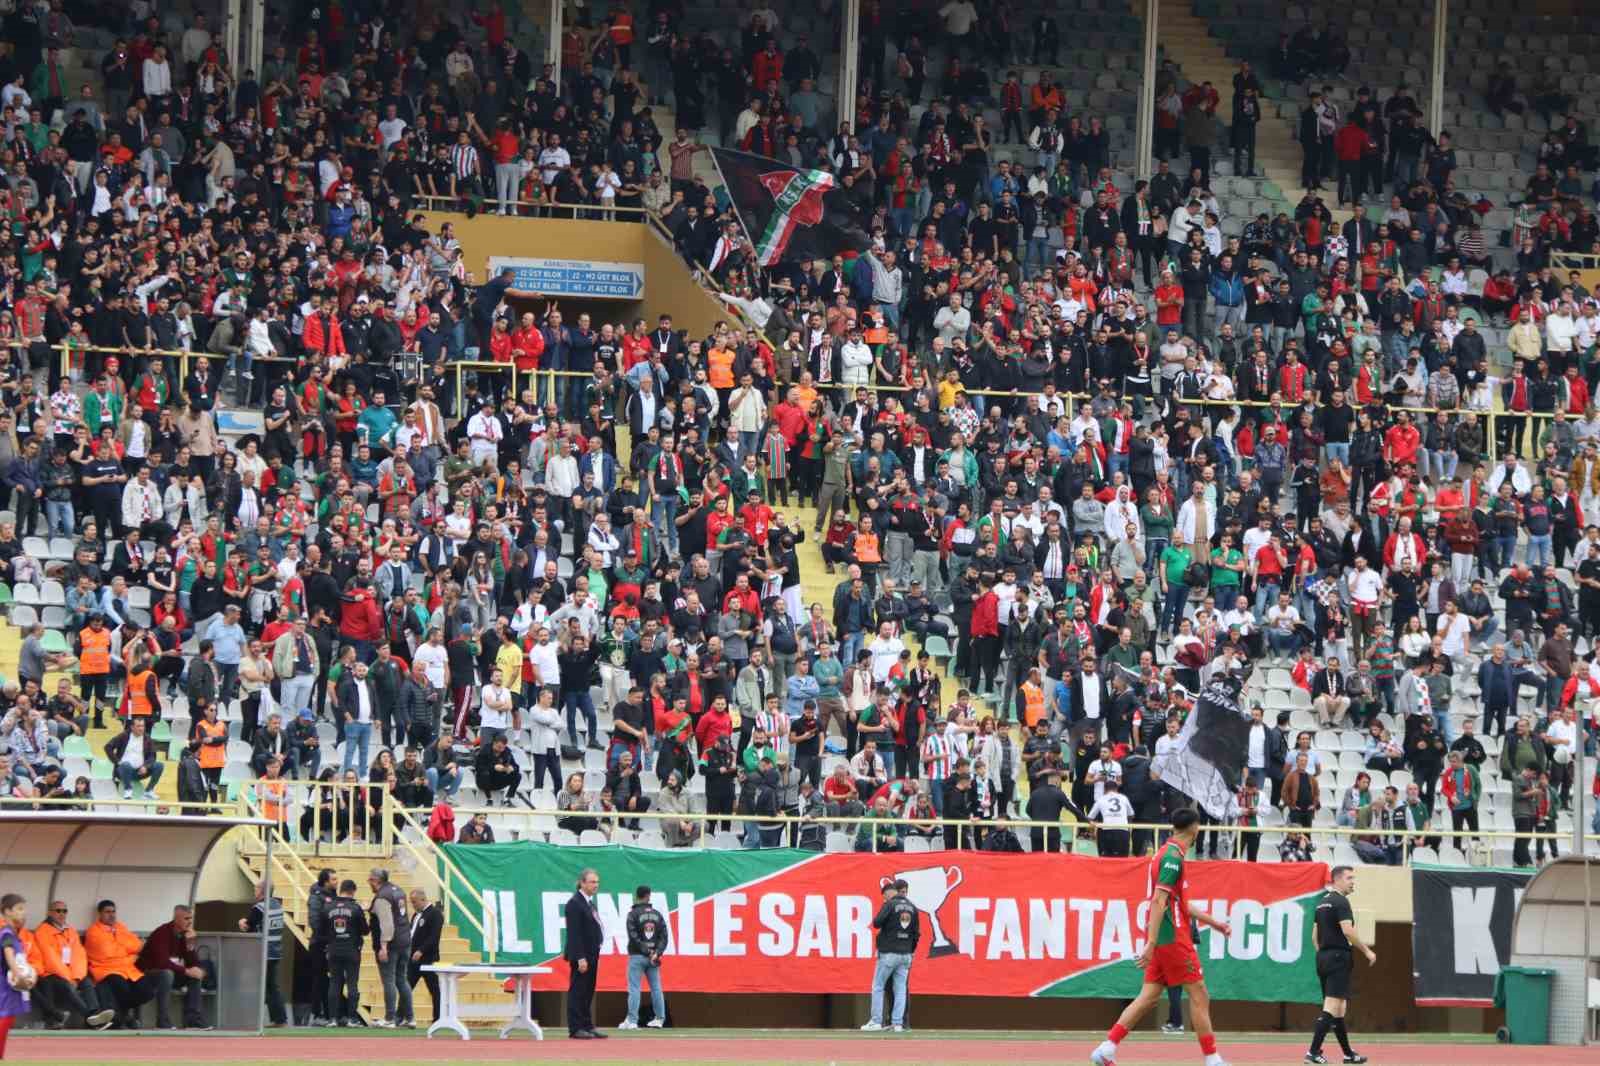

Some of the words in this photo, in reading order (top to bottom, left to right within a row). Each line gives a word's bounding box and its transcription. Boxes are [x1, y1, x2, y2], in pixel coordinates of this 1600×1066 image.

[612, 273, 630, 282] BLOK
[1108, 798, 1121, 812] 3
[482, 890, 533, 953] IL
[542, 892, 748, 957] FNALE
[758, 893, 879, 959] SAR
[958, 896, 1304, 964] FANTAICO
